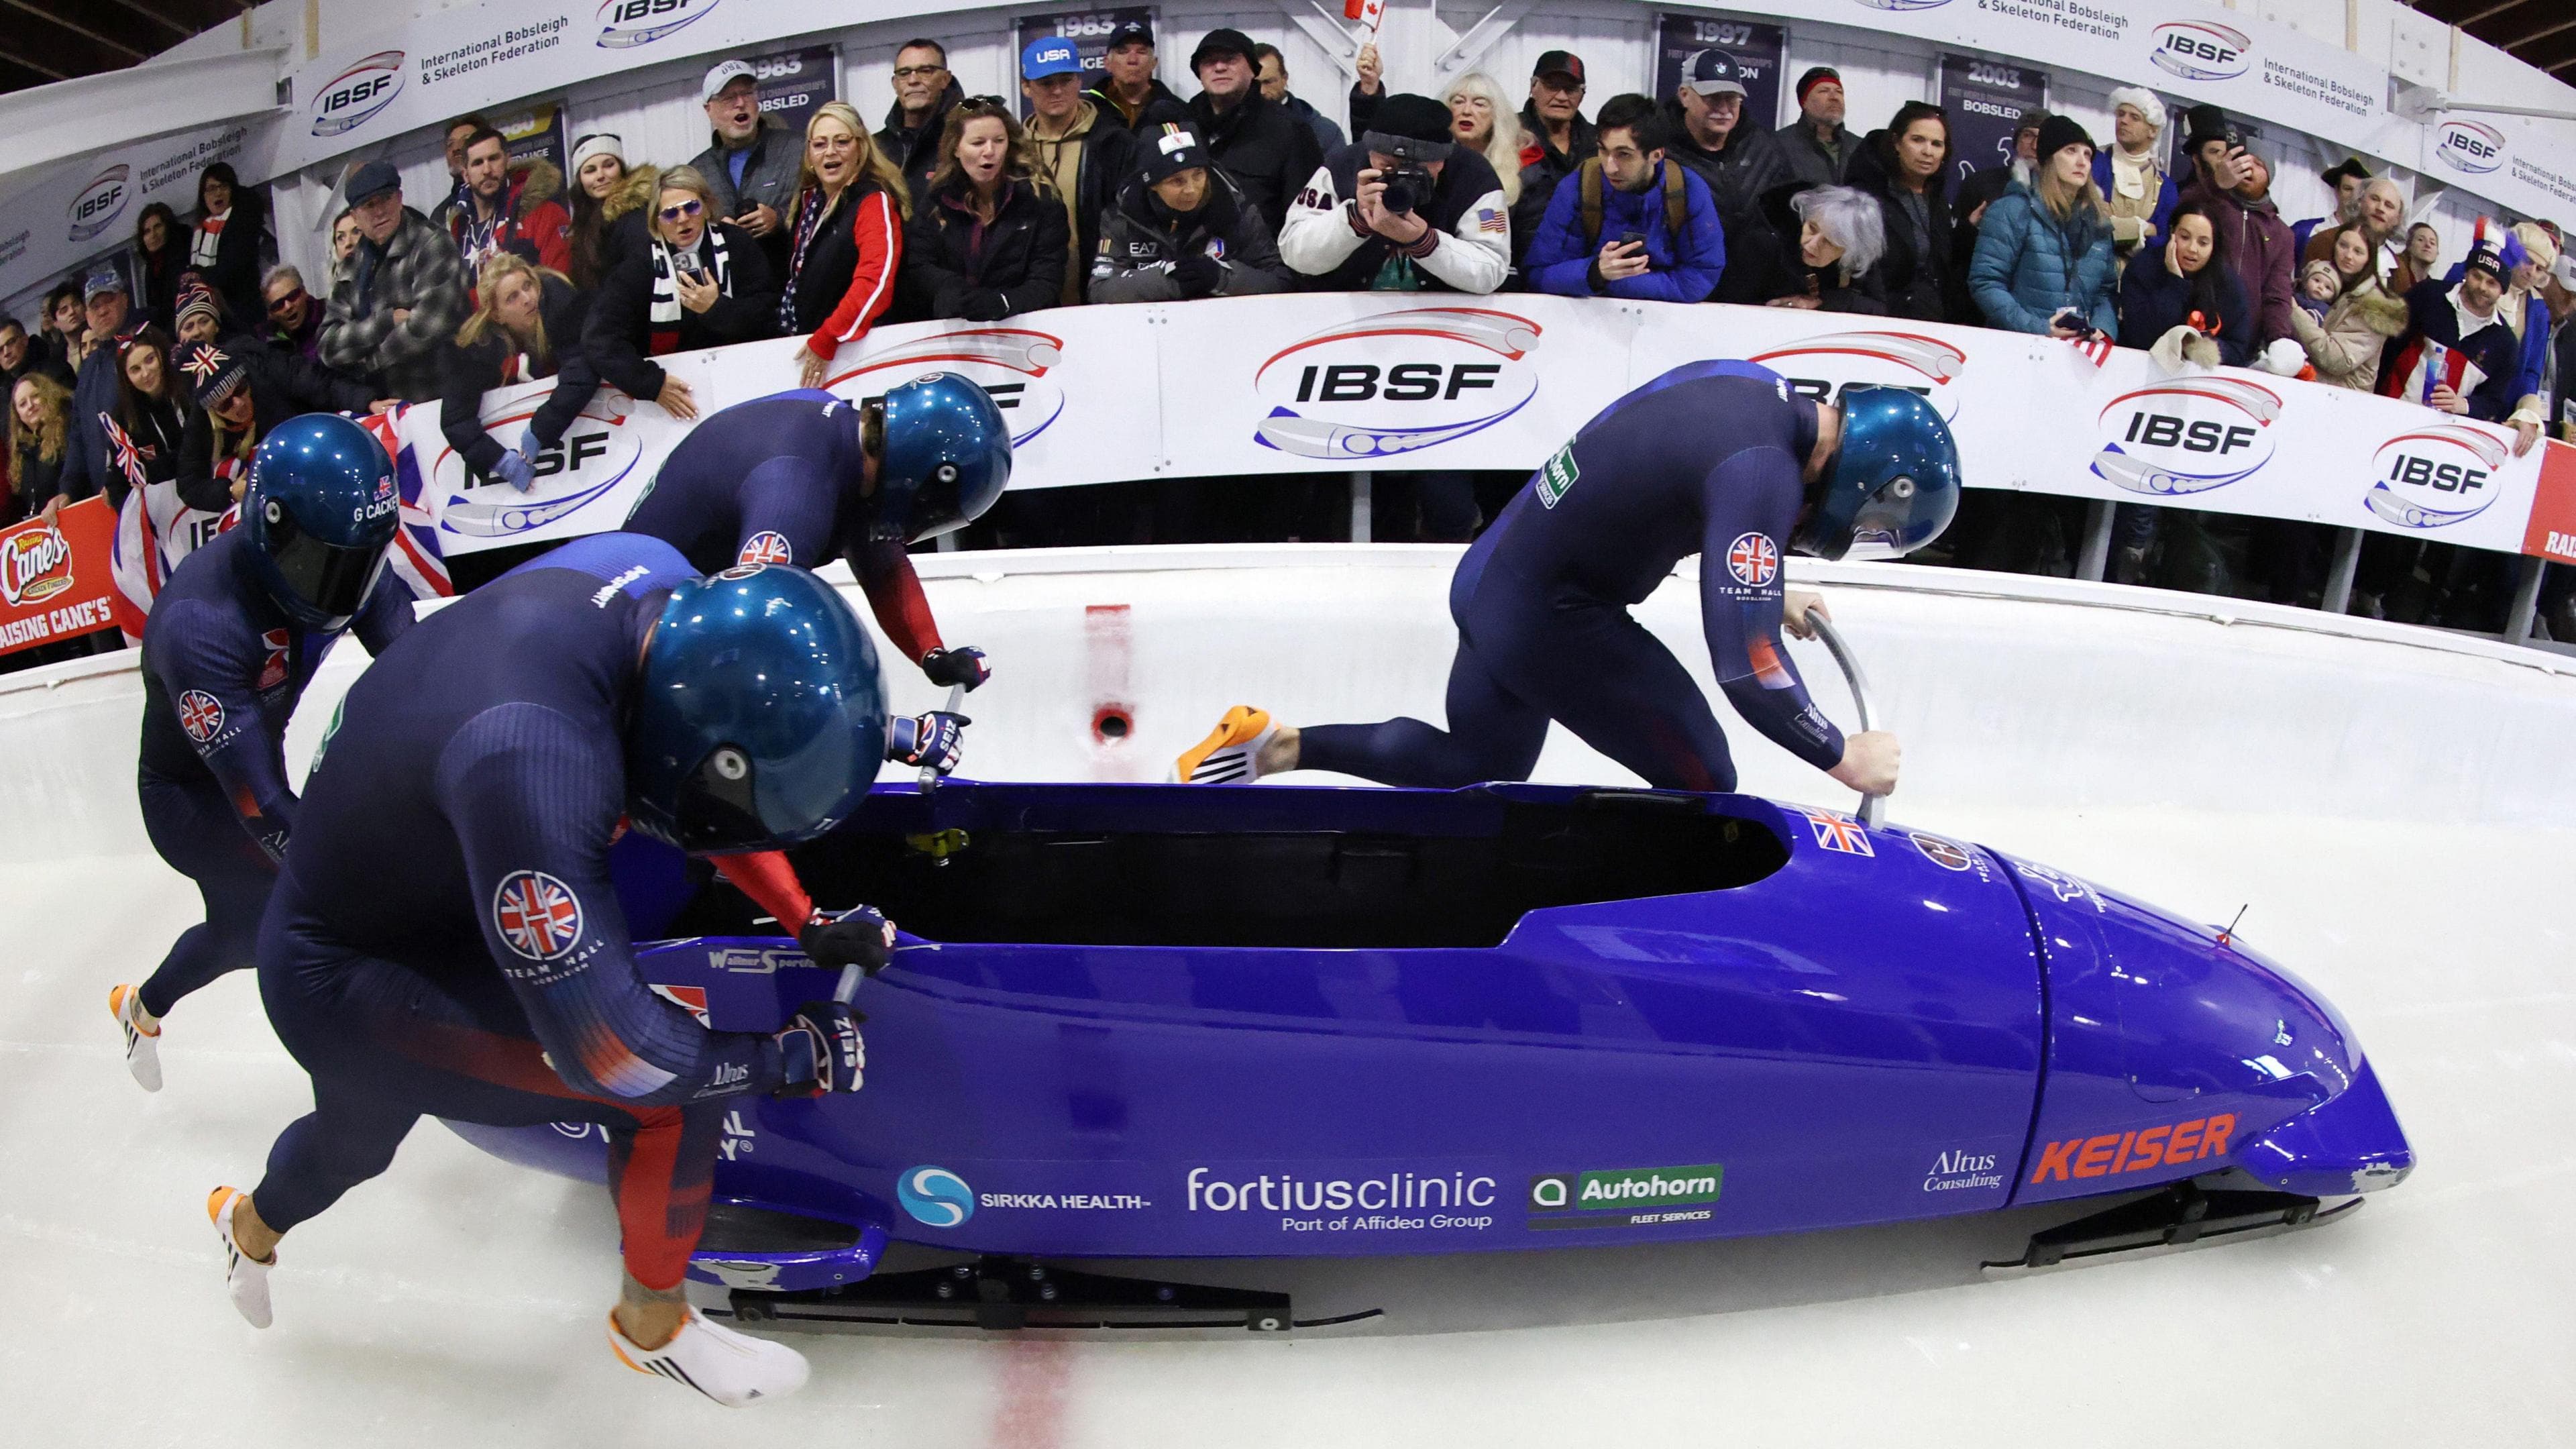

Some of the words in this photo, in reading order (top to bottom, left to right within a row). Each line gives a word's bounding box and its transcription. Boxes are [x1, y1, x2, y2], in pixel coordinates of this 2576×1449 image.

[1053, 13, 1116, 38] 1983
[1978, 0, 1988, 9] &
[1992, 0, 2050, 23] Skeleton
[2053, 14, 2119, 40] Federation
[2069, 3, 2129, 28] Bobsleigh
[421, 35, 501, 70] International
[505, 15, 568, 44] Bobsleigh
[1694, 21, 1752, 45] 1997
[422, 73, 431, 85] &
[434, 58, 488, 81] Skeleton
[492, 36, 559, 64] Federation
[1036, 48, 1071, 63] USA
[2165, 34, 2237, 63] IBSF
[721, 62, 742, 75] USA
[1968, 62, 2020, 89] 2003
[2264, 58, 2328, 89] International
[2330, 80, 2373, 106] Bobsleigh
[324, 74, 392, 113] IBSF
[758, 94, 809, 112] OBSLED
[2263, 72, 2271, 84] &
[2275, 76, 2317, 99] Skeleton
[2320, 90, 2367, 117] Federation
[1963, 99, 2022, 119] BOBSLED
[140, 147, 196, 180] International
[199, 126, 248, 155] Bobsleigh
[2448, 131, 2496, 158] IBSF
[142, 184, 148, 194] &
[149, 167, 188, 191] Skeleton
[189, 145, 241, 173] Federation
[2512, 167, 2517, 178] &
[2518, 170, 2548, 192] Skeleton
[2513, 155, 2557, 182] International
[77, 186, 122, 221] IBSF
[1297, 186, 1333, 211] USA
[1129, 241, 1159, 254] EA7
[2477, 254, 2501, 273] USA
[1296, 364, 1501, 402] IBSF
[2125, 411, 2257, 454] IBSF
[464, 432, 609, 490] ISF
[2390, 454, 2487, 494] IBSF
[354, 507, 363, 522] G
[1719, 586, 1752, 594] TEAM
[0, 614, 50, 649] AISING
[50, 596, 111, 634] CANE'S
[215, 727, 242, 745] HALL
[939, 719, 957, 752] SEIZ
[504, 964, 551, 979] TEAM
[565, 939, 604, 966] HALL
[1927, 1149, 1996, 1175] Altus
[2030, 1113, 2236, 1184] KEISER
[1187, 1167, 1496, 1212] fortiusclinic
[1580, 1175, 1715, 1201] Autohorn
[1923, 1172, 2003, 1192] Consulting
[980, 1193, 1057, 1208] SIRKKA
[1282, 1218, 1323, 1232] Part
[1328, 1216, 1348, 1231] of
[1352, 1215, 1424, 1230] Affidea
[1430, 1214, 1493, 1230] Group
[1631, 1214, 1660, 1224] FLEET
[1662, 1210, 1711, 1222] SERVICES
